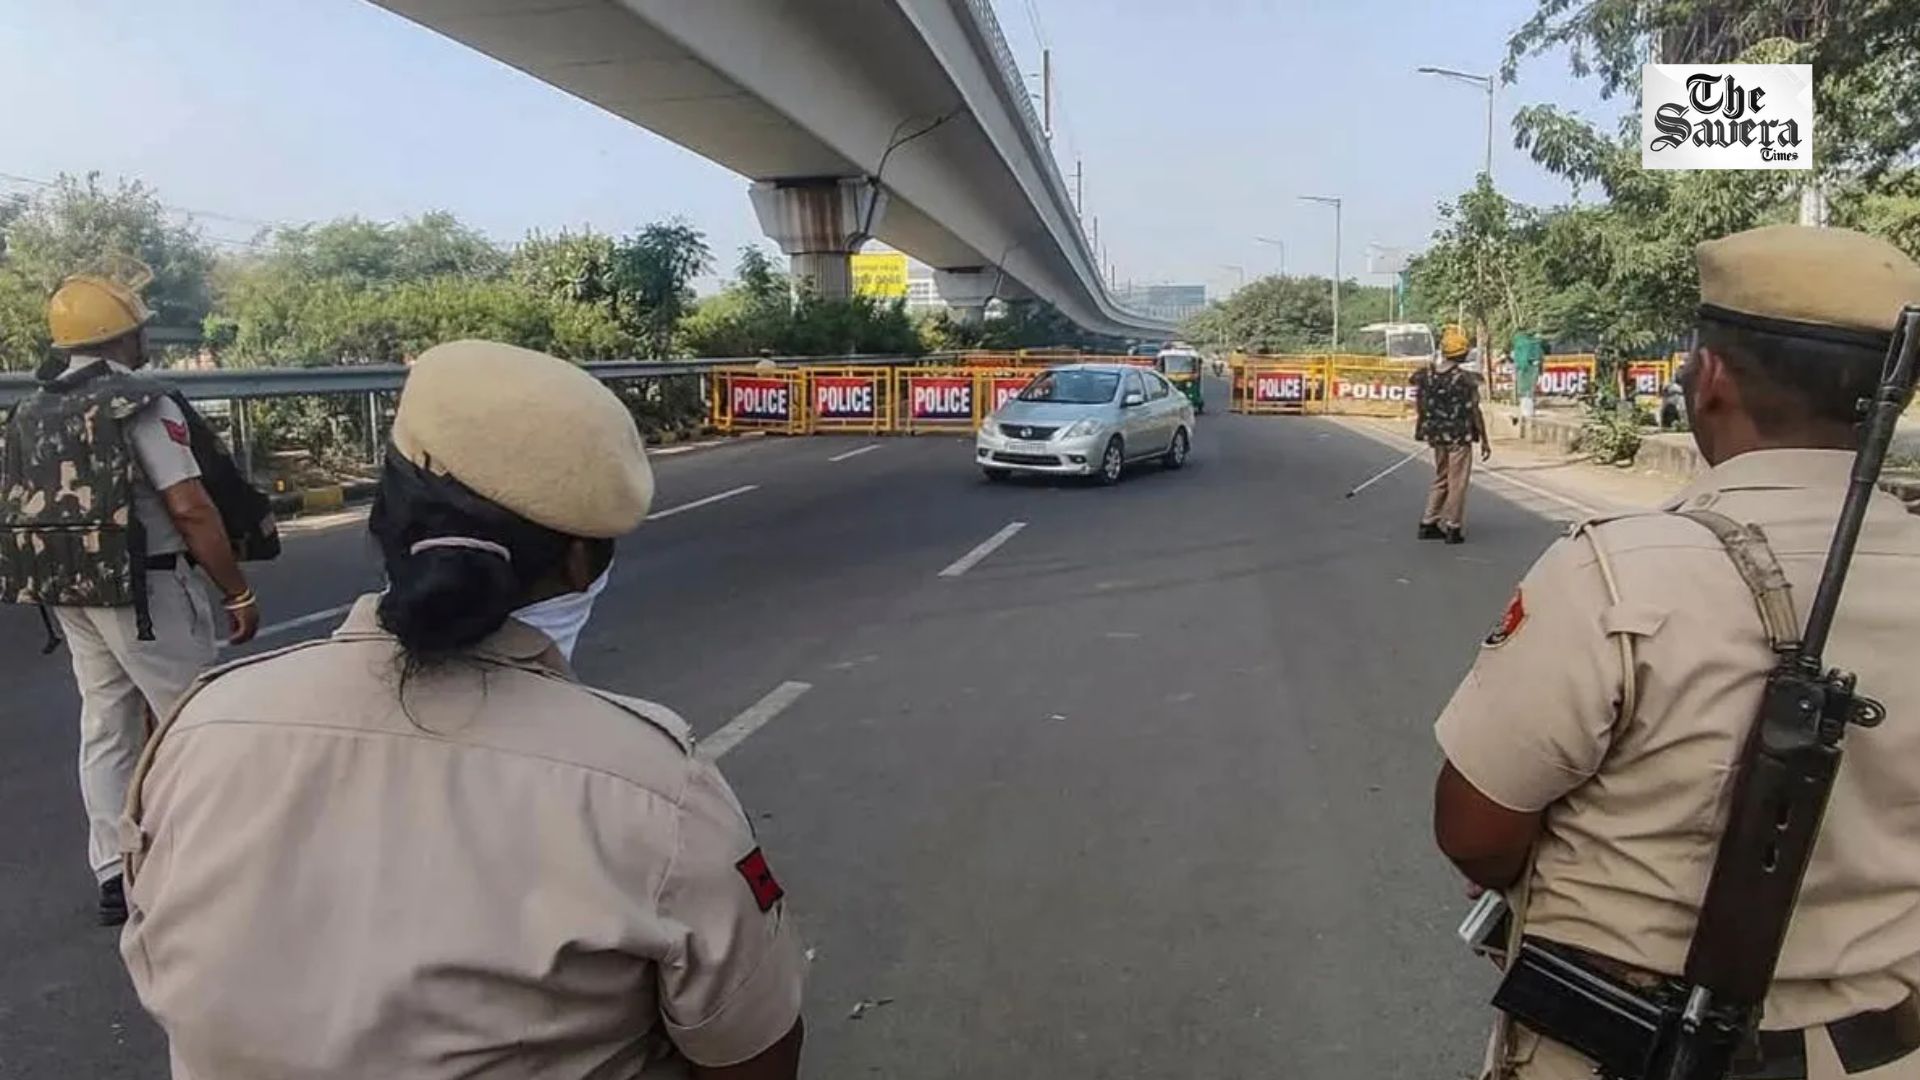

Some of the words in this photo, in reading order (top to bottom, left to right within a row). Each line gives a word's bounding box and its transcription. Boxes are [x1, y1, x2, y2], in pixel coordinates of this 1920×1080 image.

[1258, 378, 1301, 398] POLICE
[1338, 382, 1419, 401] POLICE
[1537, 371, 1587, 394] OLICE
[733, 386, 787, 414] POLICE
[817, 386, 871, 411] POLICE
[914, 386, 970, 411] POLICE
